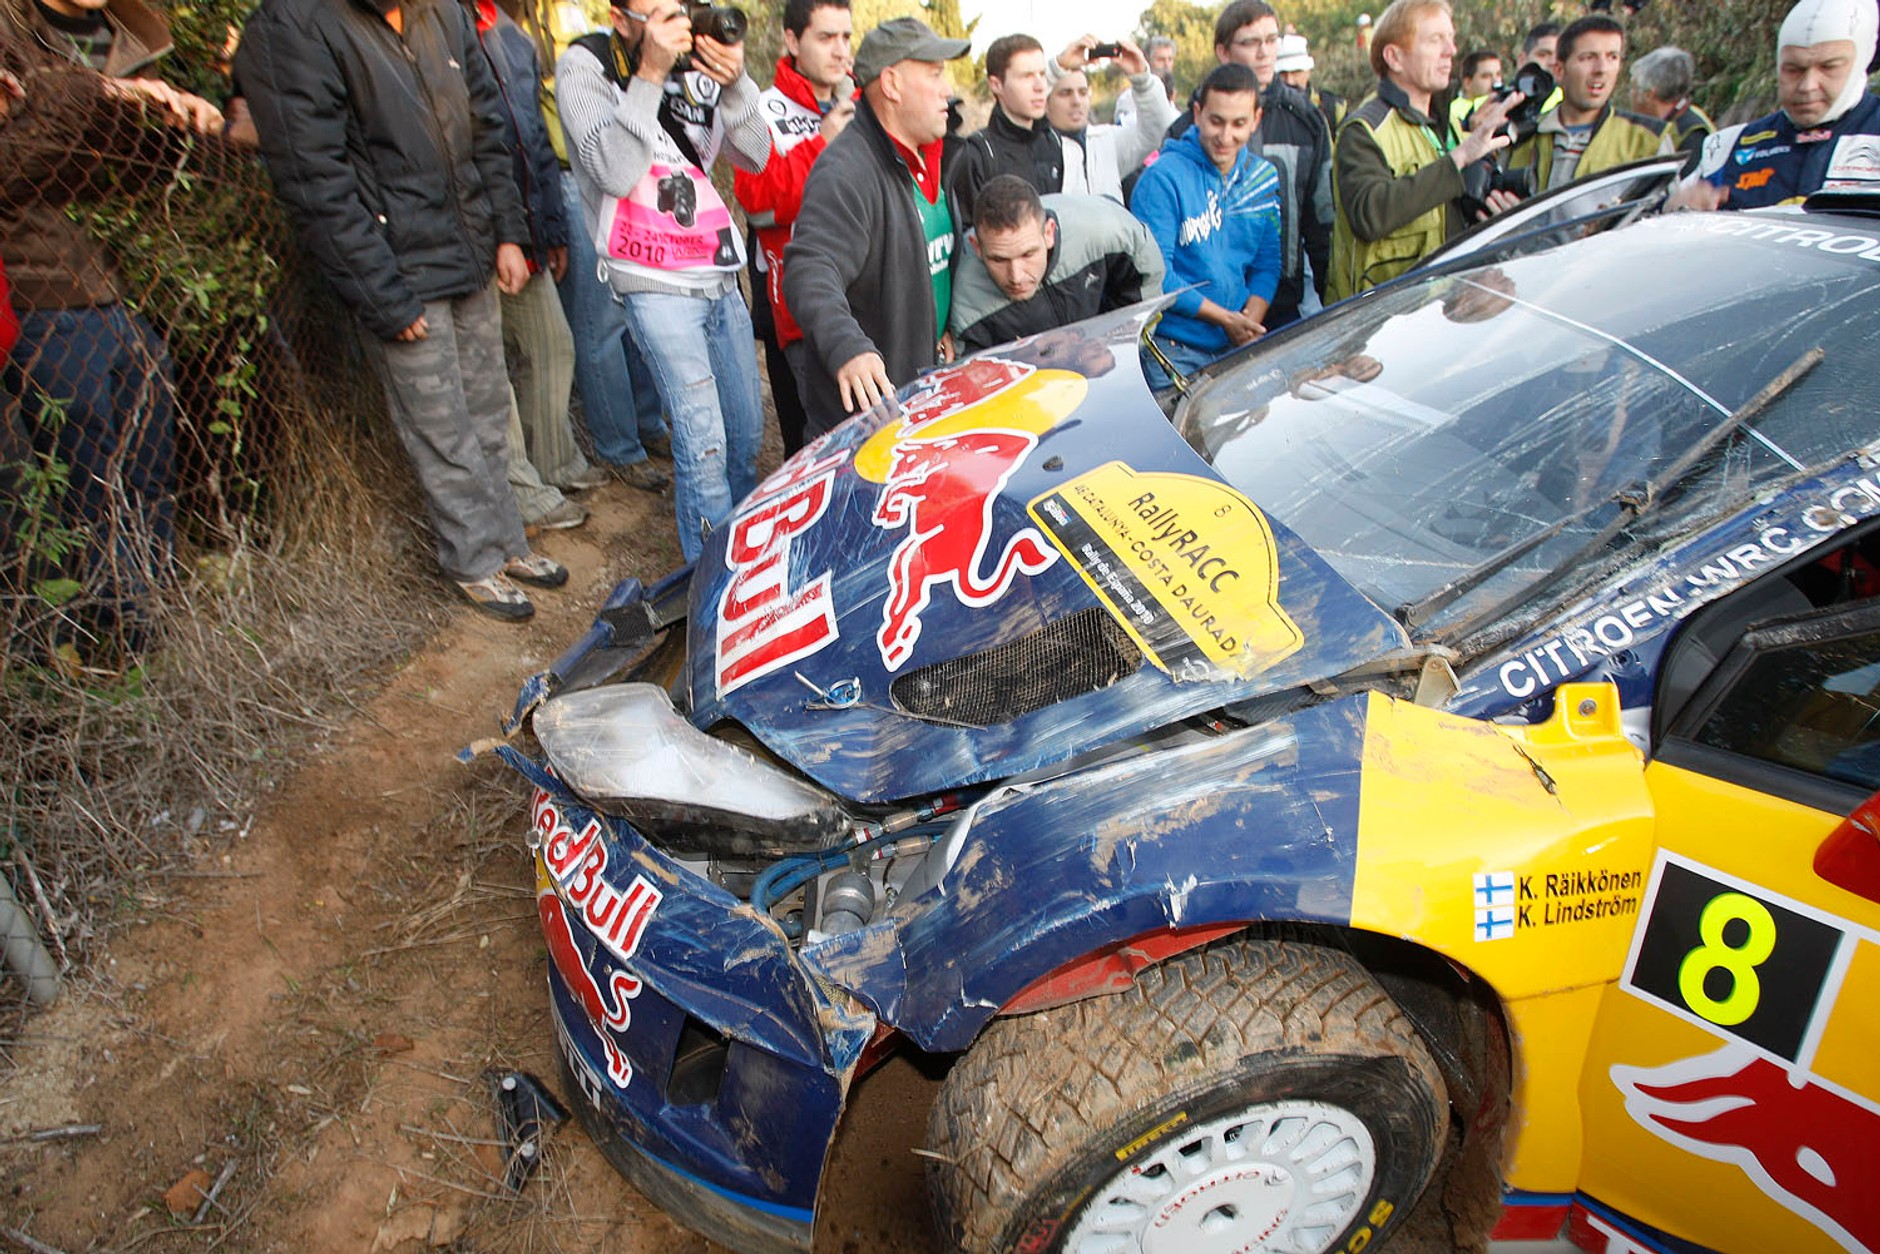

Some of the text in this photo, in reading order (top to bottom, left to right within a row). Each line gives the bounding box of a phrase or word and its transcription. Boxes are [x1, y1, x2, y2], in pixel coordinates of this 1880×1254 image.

[617, 235, 665, 263] 2010
[1128, 491, 1240, 593] RallyRACC
[1130, 599, 1155, 625] 2010
[1519, 869, 1641, 900] K. Räikkönen
[1518, 894, 1637, 928] K. Lindström
[1678, 892, 1777, 1026] 8
